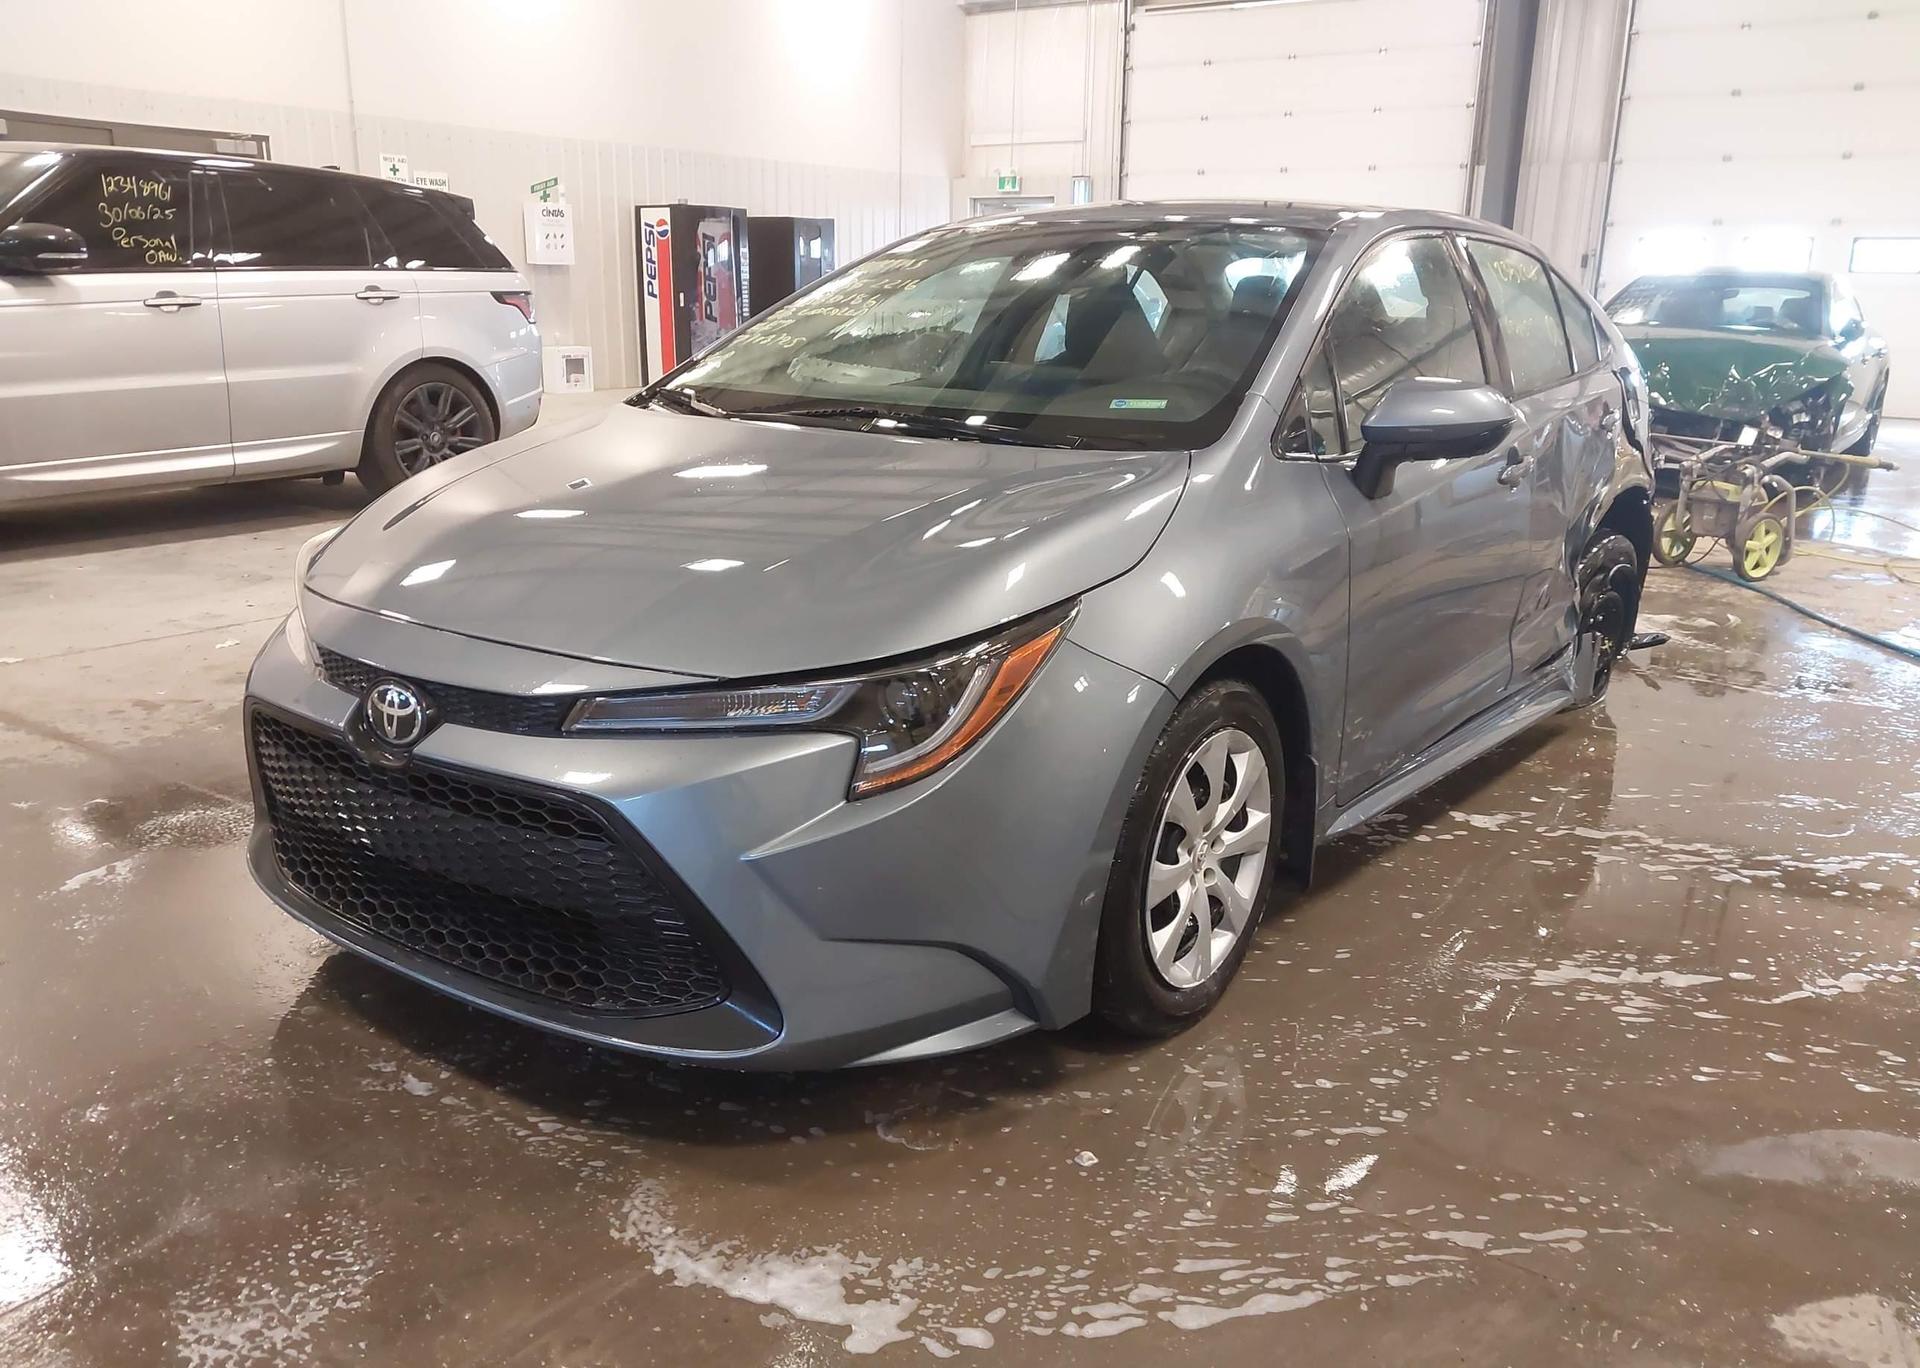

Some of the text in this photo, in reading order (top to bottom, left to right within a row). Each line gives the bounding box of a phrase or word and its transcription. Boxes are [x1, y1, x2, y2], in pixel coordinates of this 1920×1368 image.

[415, 177, 446, 187] EYE WASH
[98, 202, 177, 229] 30/06/25
[644, 221, 658, 299] PEPSI
